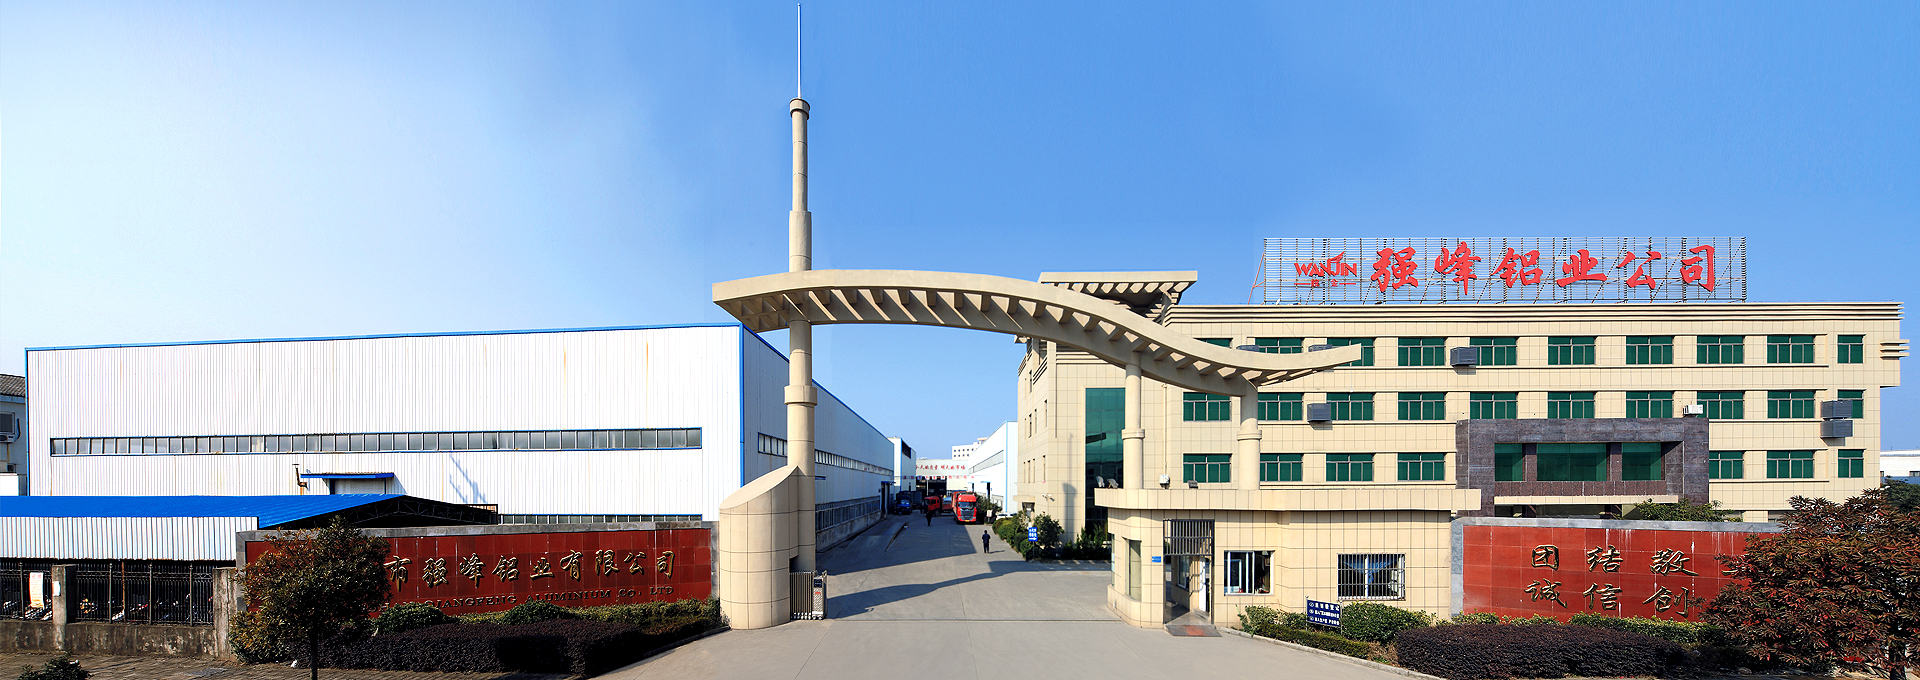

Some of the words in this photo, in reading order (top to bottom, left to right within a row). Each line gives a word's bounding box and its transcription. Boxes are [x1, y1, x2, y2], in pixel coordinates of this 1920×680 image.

[1294, 252, 1358, 277] WANJIN
[1370, 241, 1715, 295] 强峰铝业公司
[383, 550, 676, 592] 市强峰铝业有限公司
[1531, 544, 1740, 577] 团结敬
[525, 588, 611, 603] ALUMINIUM
[649, 586, 674, 596] LTD
[1523, 577, 1691, 617] 诚信创
